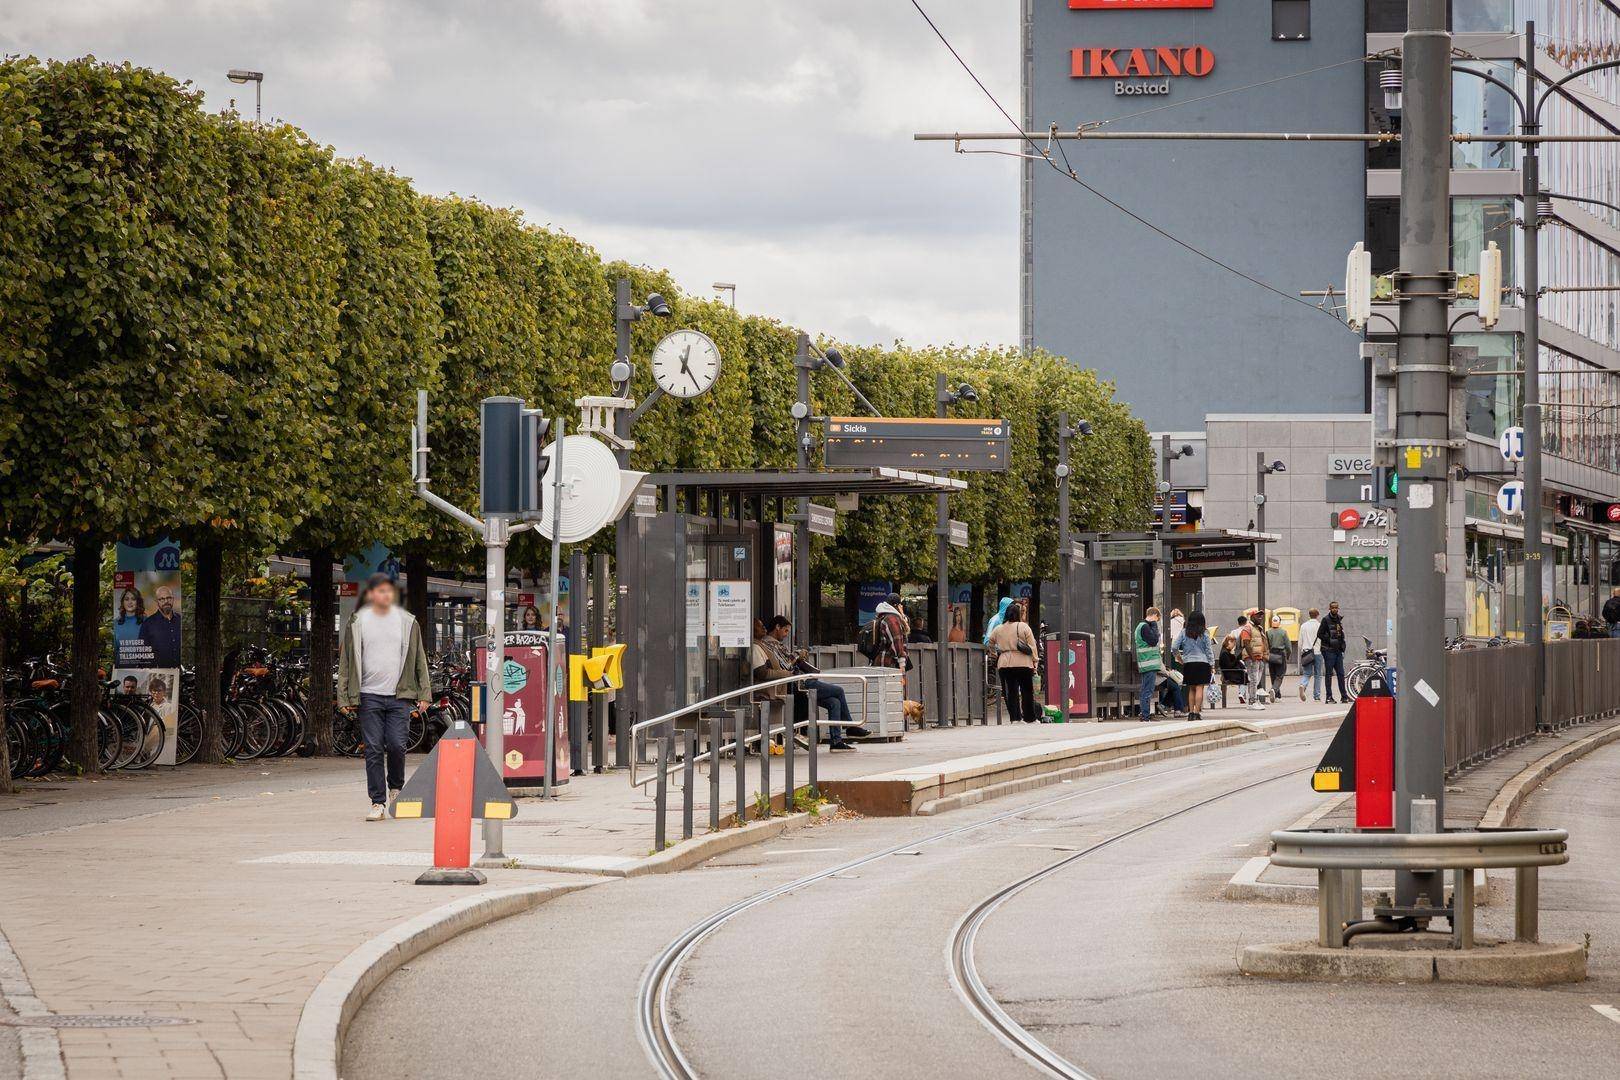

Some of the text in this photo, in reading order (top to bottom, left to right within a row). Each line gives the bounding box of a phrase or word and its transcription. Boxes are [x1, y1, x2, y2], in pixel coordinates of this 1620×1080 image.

[1070, 46, 1215, 78] IKANO
[1114, 80, 1170, 96] Bostad
[844, 424, 867, 432] Sickla
[1350, 535, 1389, 548] Pressb
[1176, 550, 1184, 560] D
